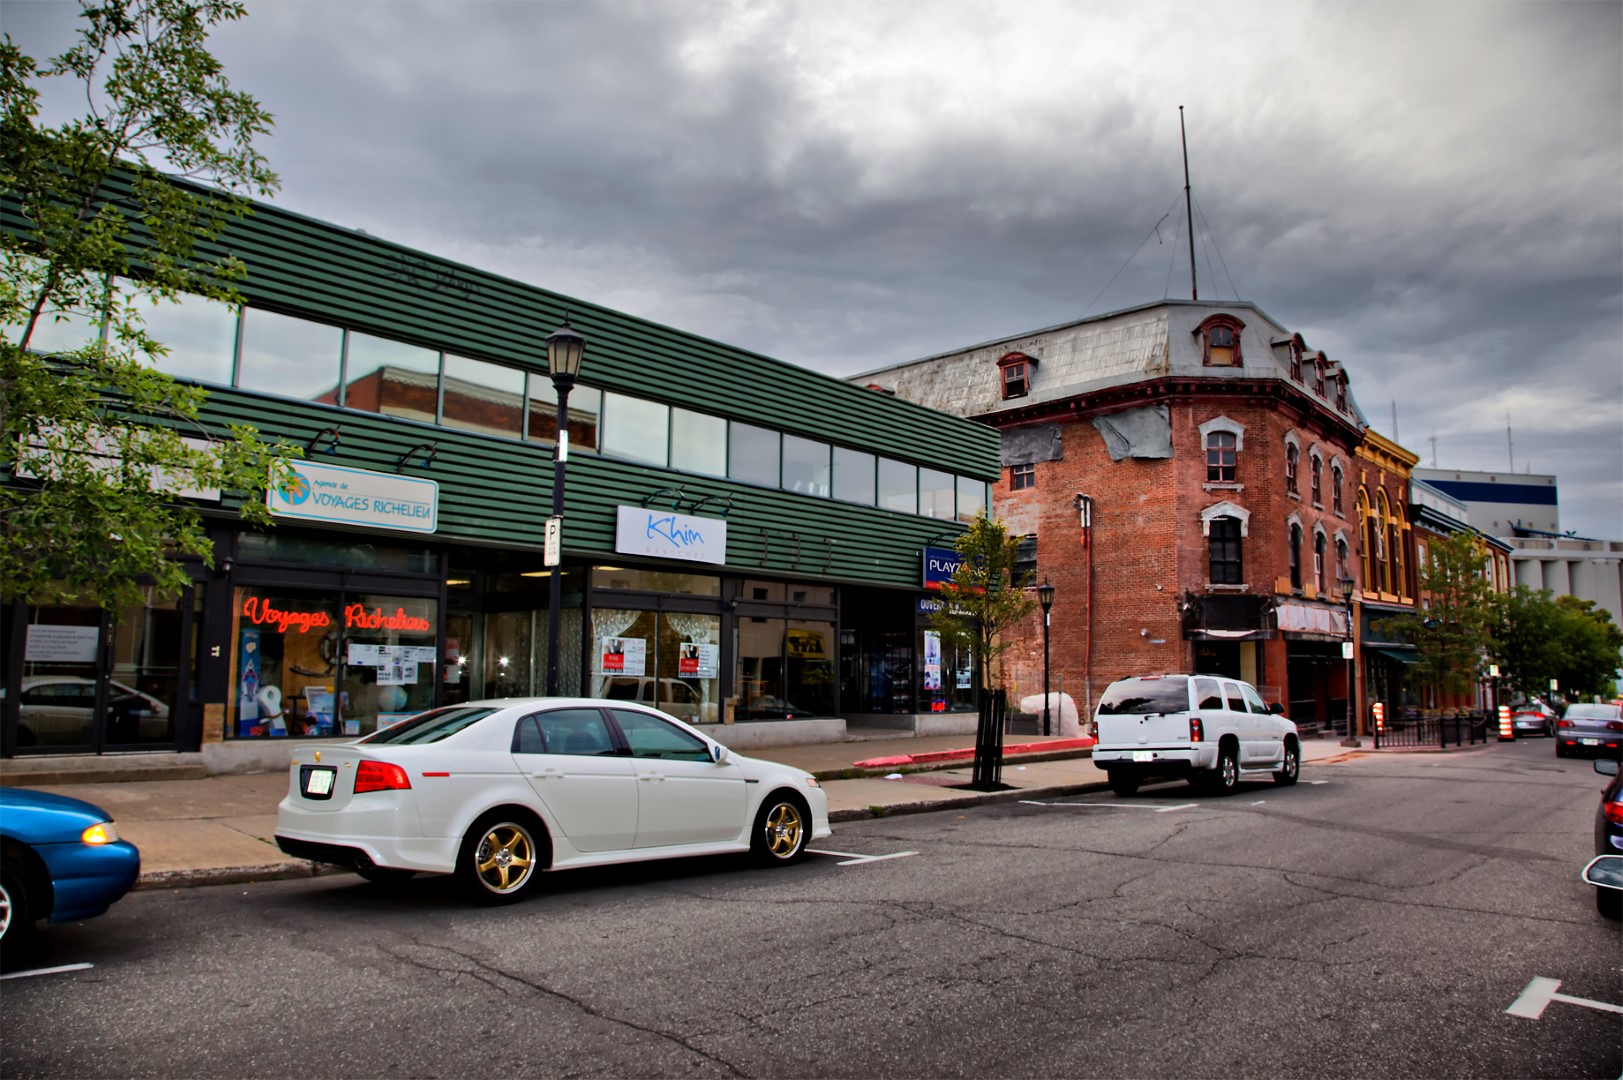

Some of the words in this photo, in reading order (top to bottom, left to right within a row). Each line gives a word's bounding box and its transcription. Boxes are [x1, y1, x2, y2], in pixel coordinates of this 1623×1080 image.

[313, 491, 368, 511] VOYAGES
[549, 524, 556, 540] P
[243, 597, 330, 633] Voyages
